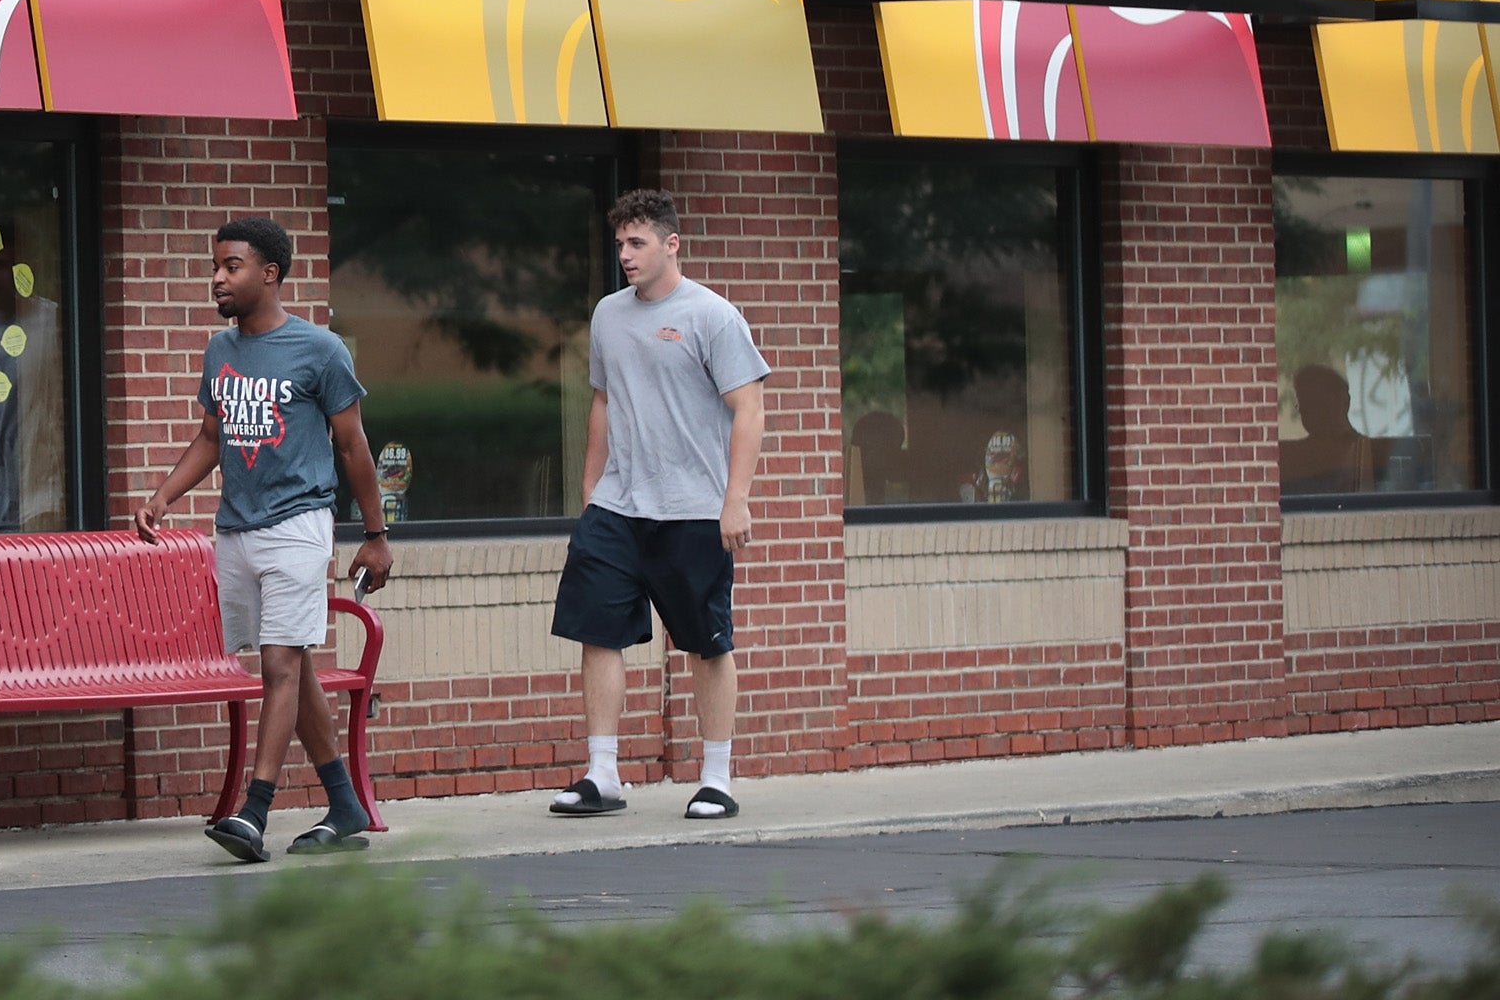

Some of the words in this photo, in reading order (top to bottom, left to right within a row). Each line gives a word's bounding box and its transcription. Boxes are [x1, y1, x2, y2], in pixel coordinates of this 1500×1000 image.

[211, 377, 292, 403] ILLINOIS
[221, 400, 274, 424] STATE
[223, 424, 272, 436] UNIVERSITY
